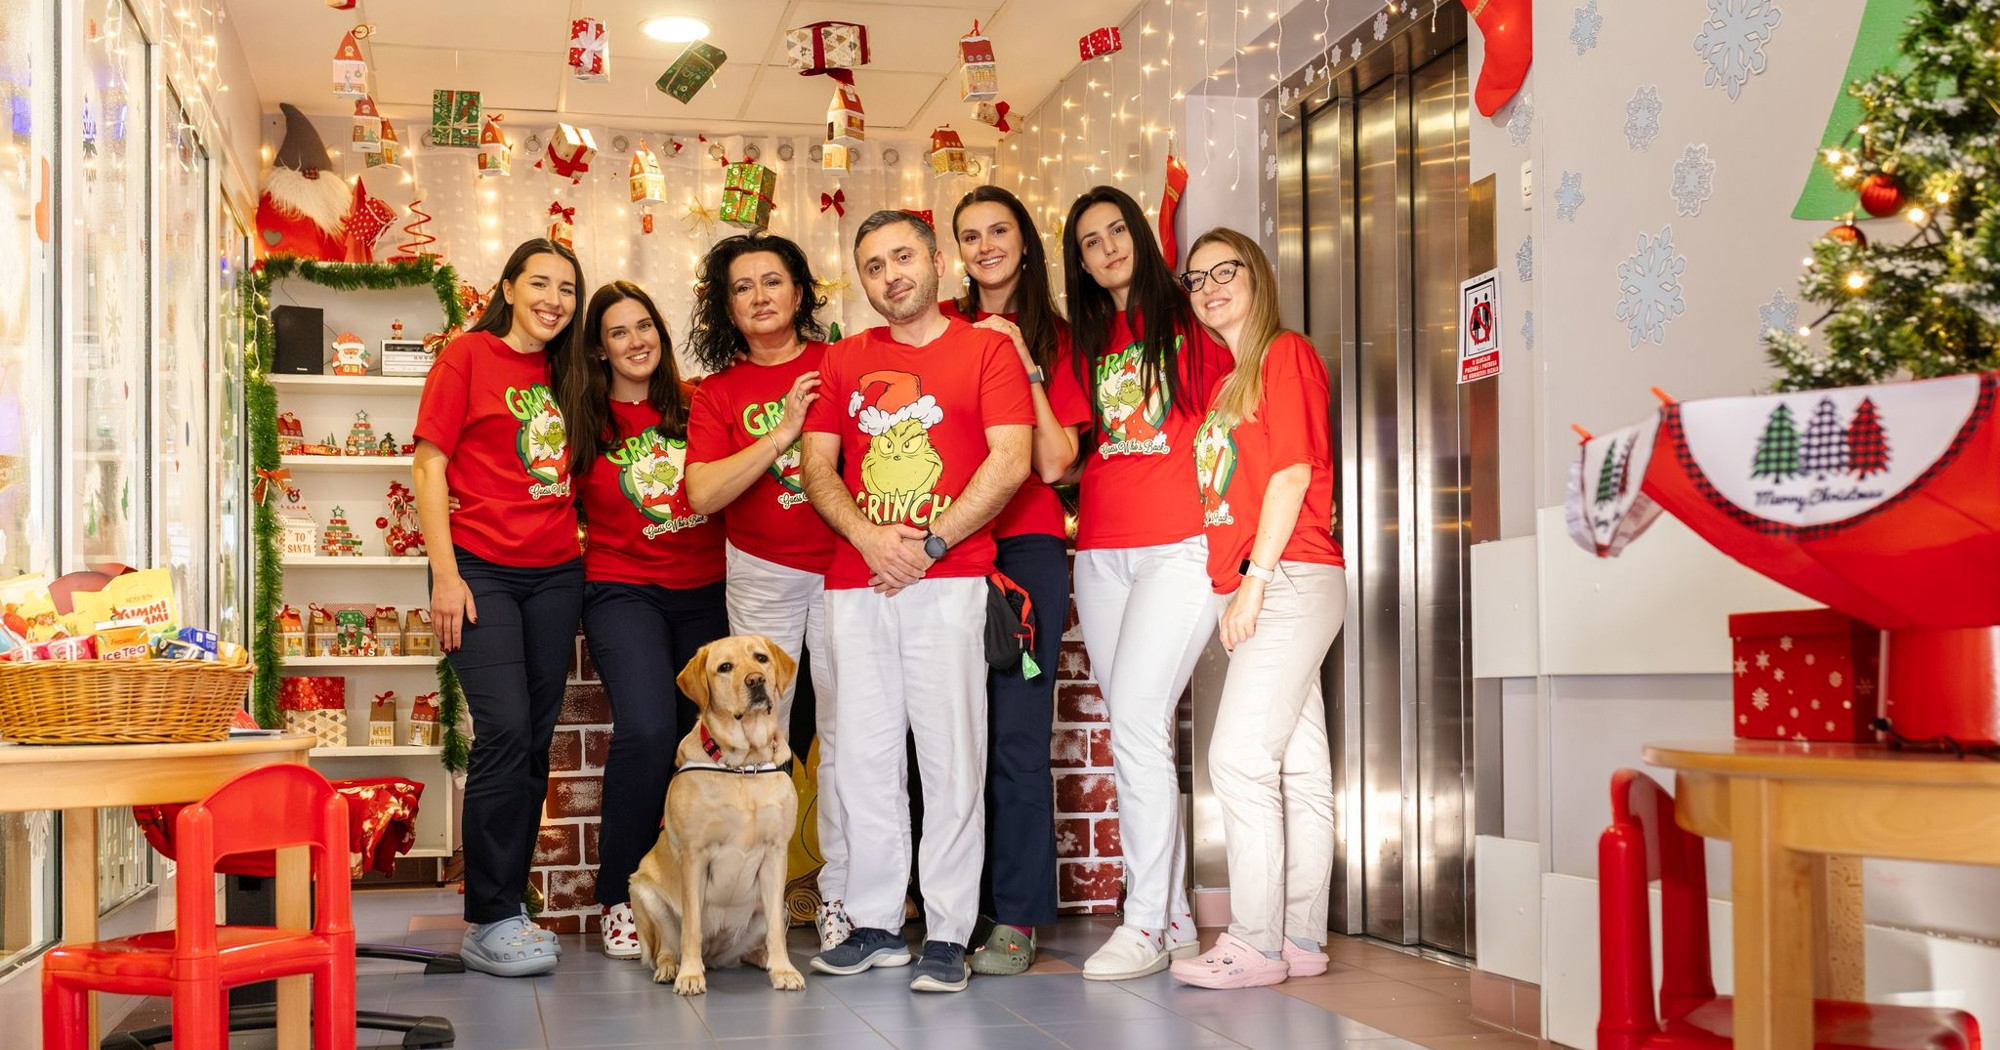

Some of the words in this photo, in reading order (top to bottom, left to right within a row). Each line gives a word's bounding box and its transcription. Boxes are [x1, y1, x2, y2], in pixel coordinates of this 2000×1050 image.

[779, 493, 803, 510] Guess
[1755, 489, 1806, 513] Merry
[1807, 486, 1884, 506] Christmas
[295, 532, 305, 542] TO
[287, 544, 311, 553] SANTA
[102, 651, 121, 661] Ice
[122, 645, 146, 658] Tea
